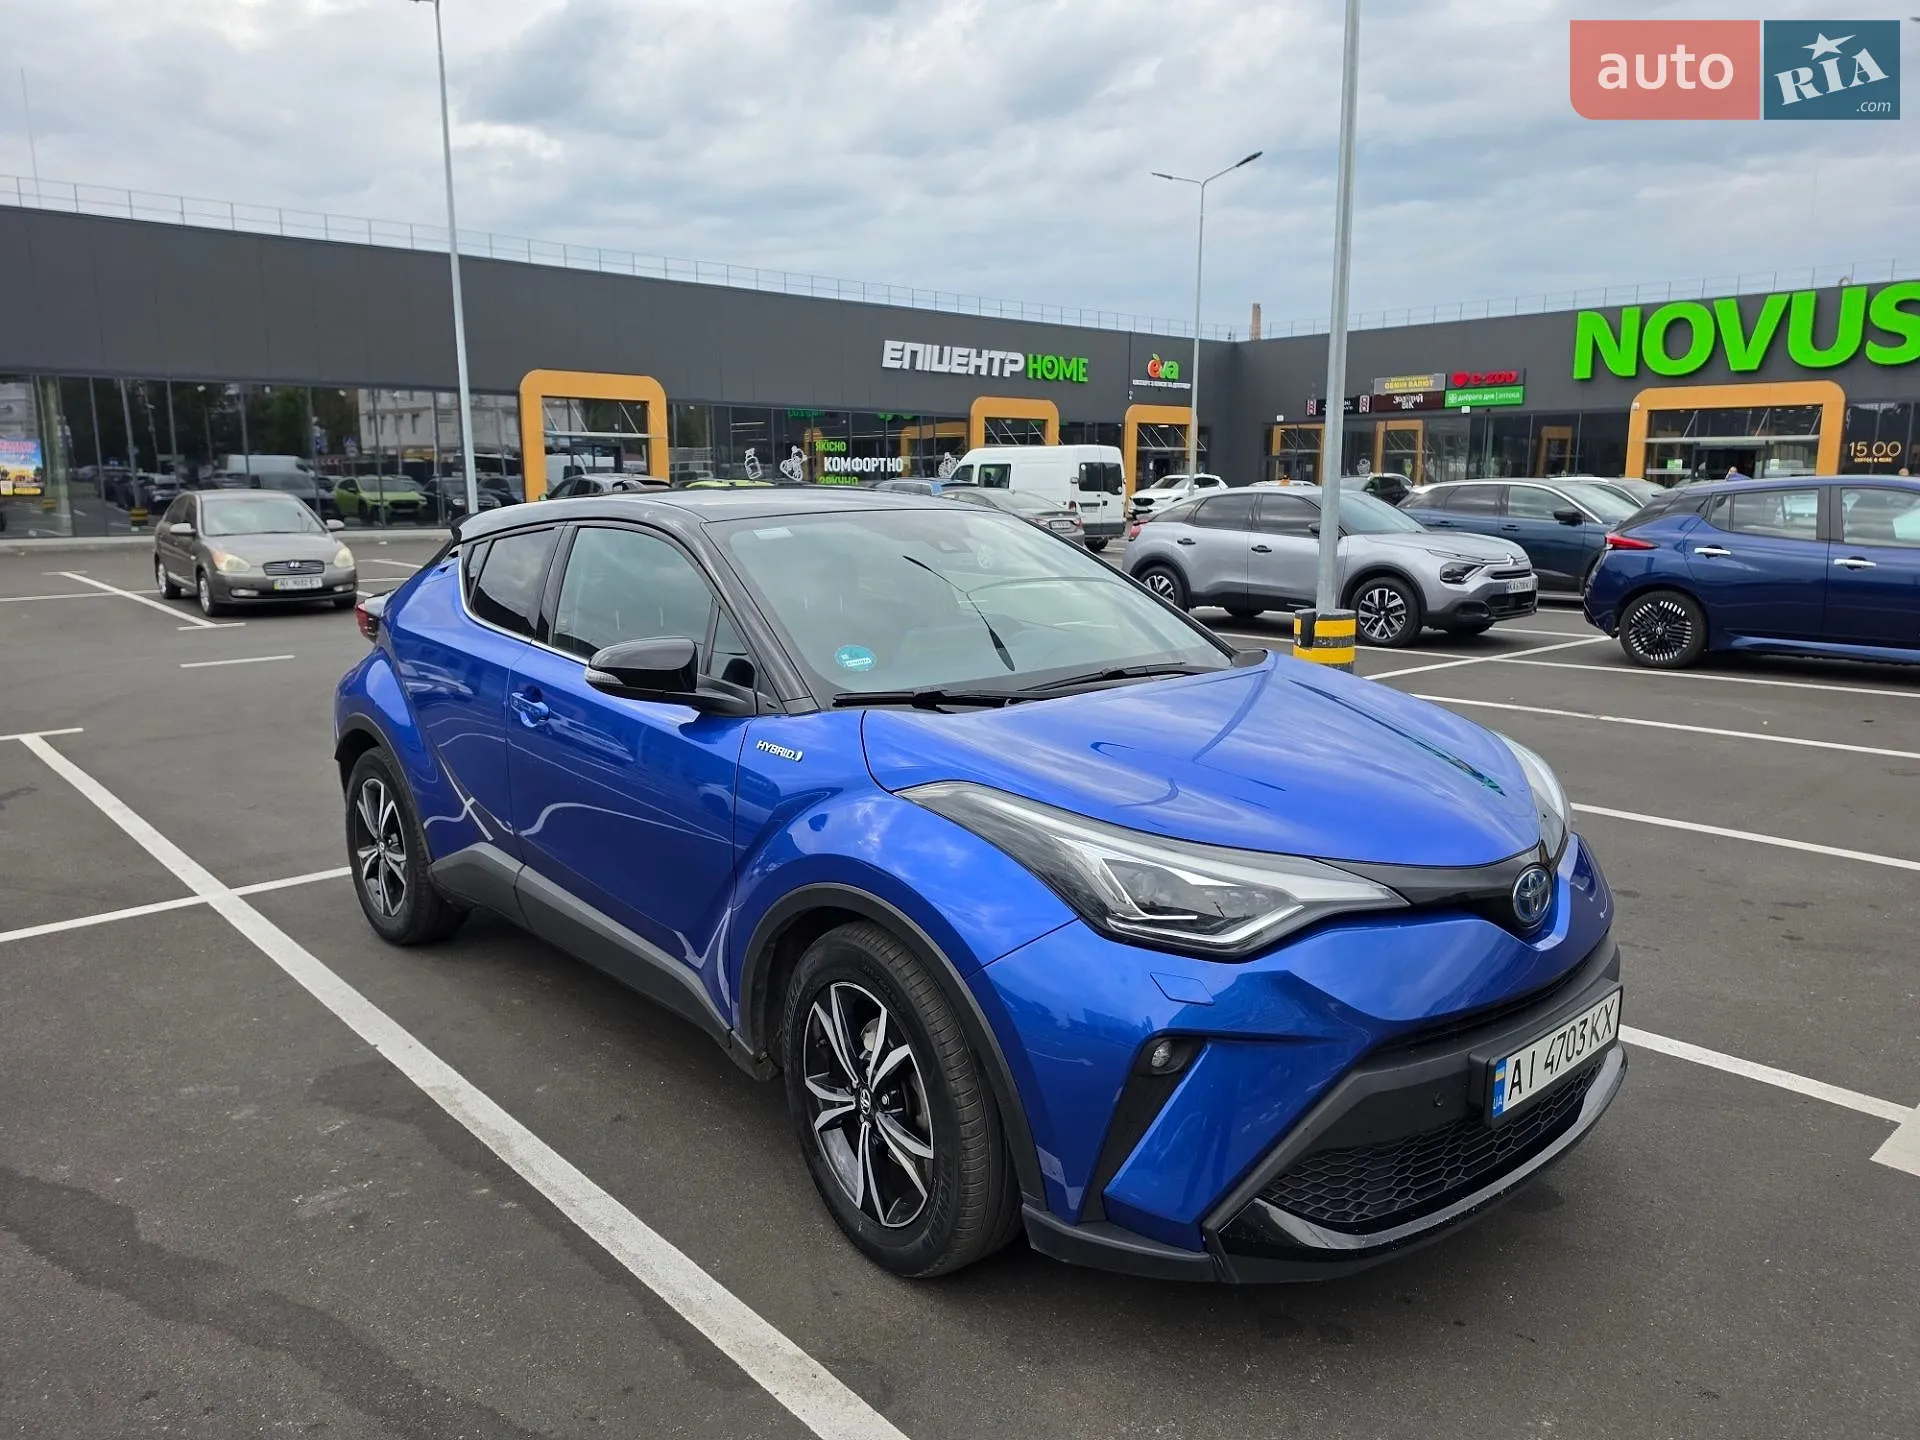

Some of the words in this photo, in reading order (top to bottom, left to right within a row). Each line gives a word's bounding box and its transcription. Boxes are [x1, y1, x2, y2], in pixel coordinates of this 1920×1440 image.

[881, 340, 1025, 378] ЕПІЦЕНТР
[1026, 353, 1089, 383] HOME
[1572, 280, 1920, 381] NOVUS
[823, 456, 904, 473] КОМФОРТНО
[1507, 1050, 1536, 1101] AI
[1543, 1017, 1588, 1075] 4703
[1589, 998, 1616, 1049] KX
